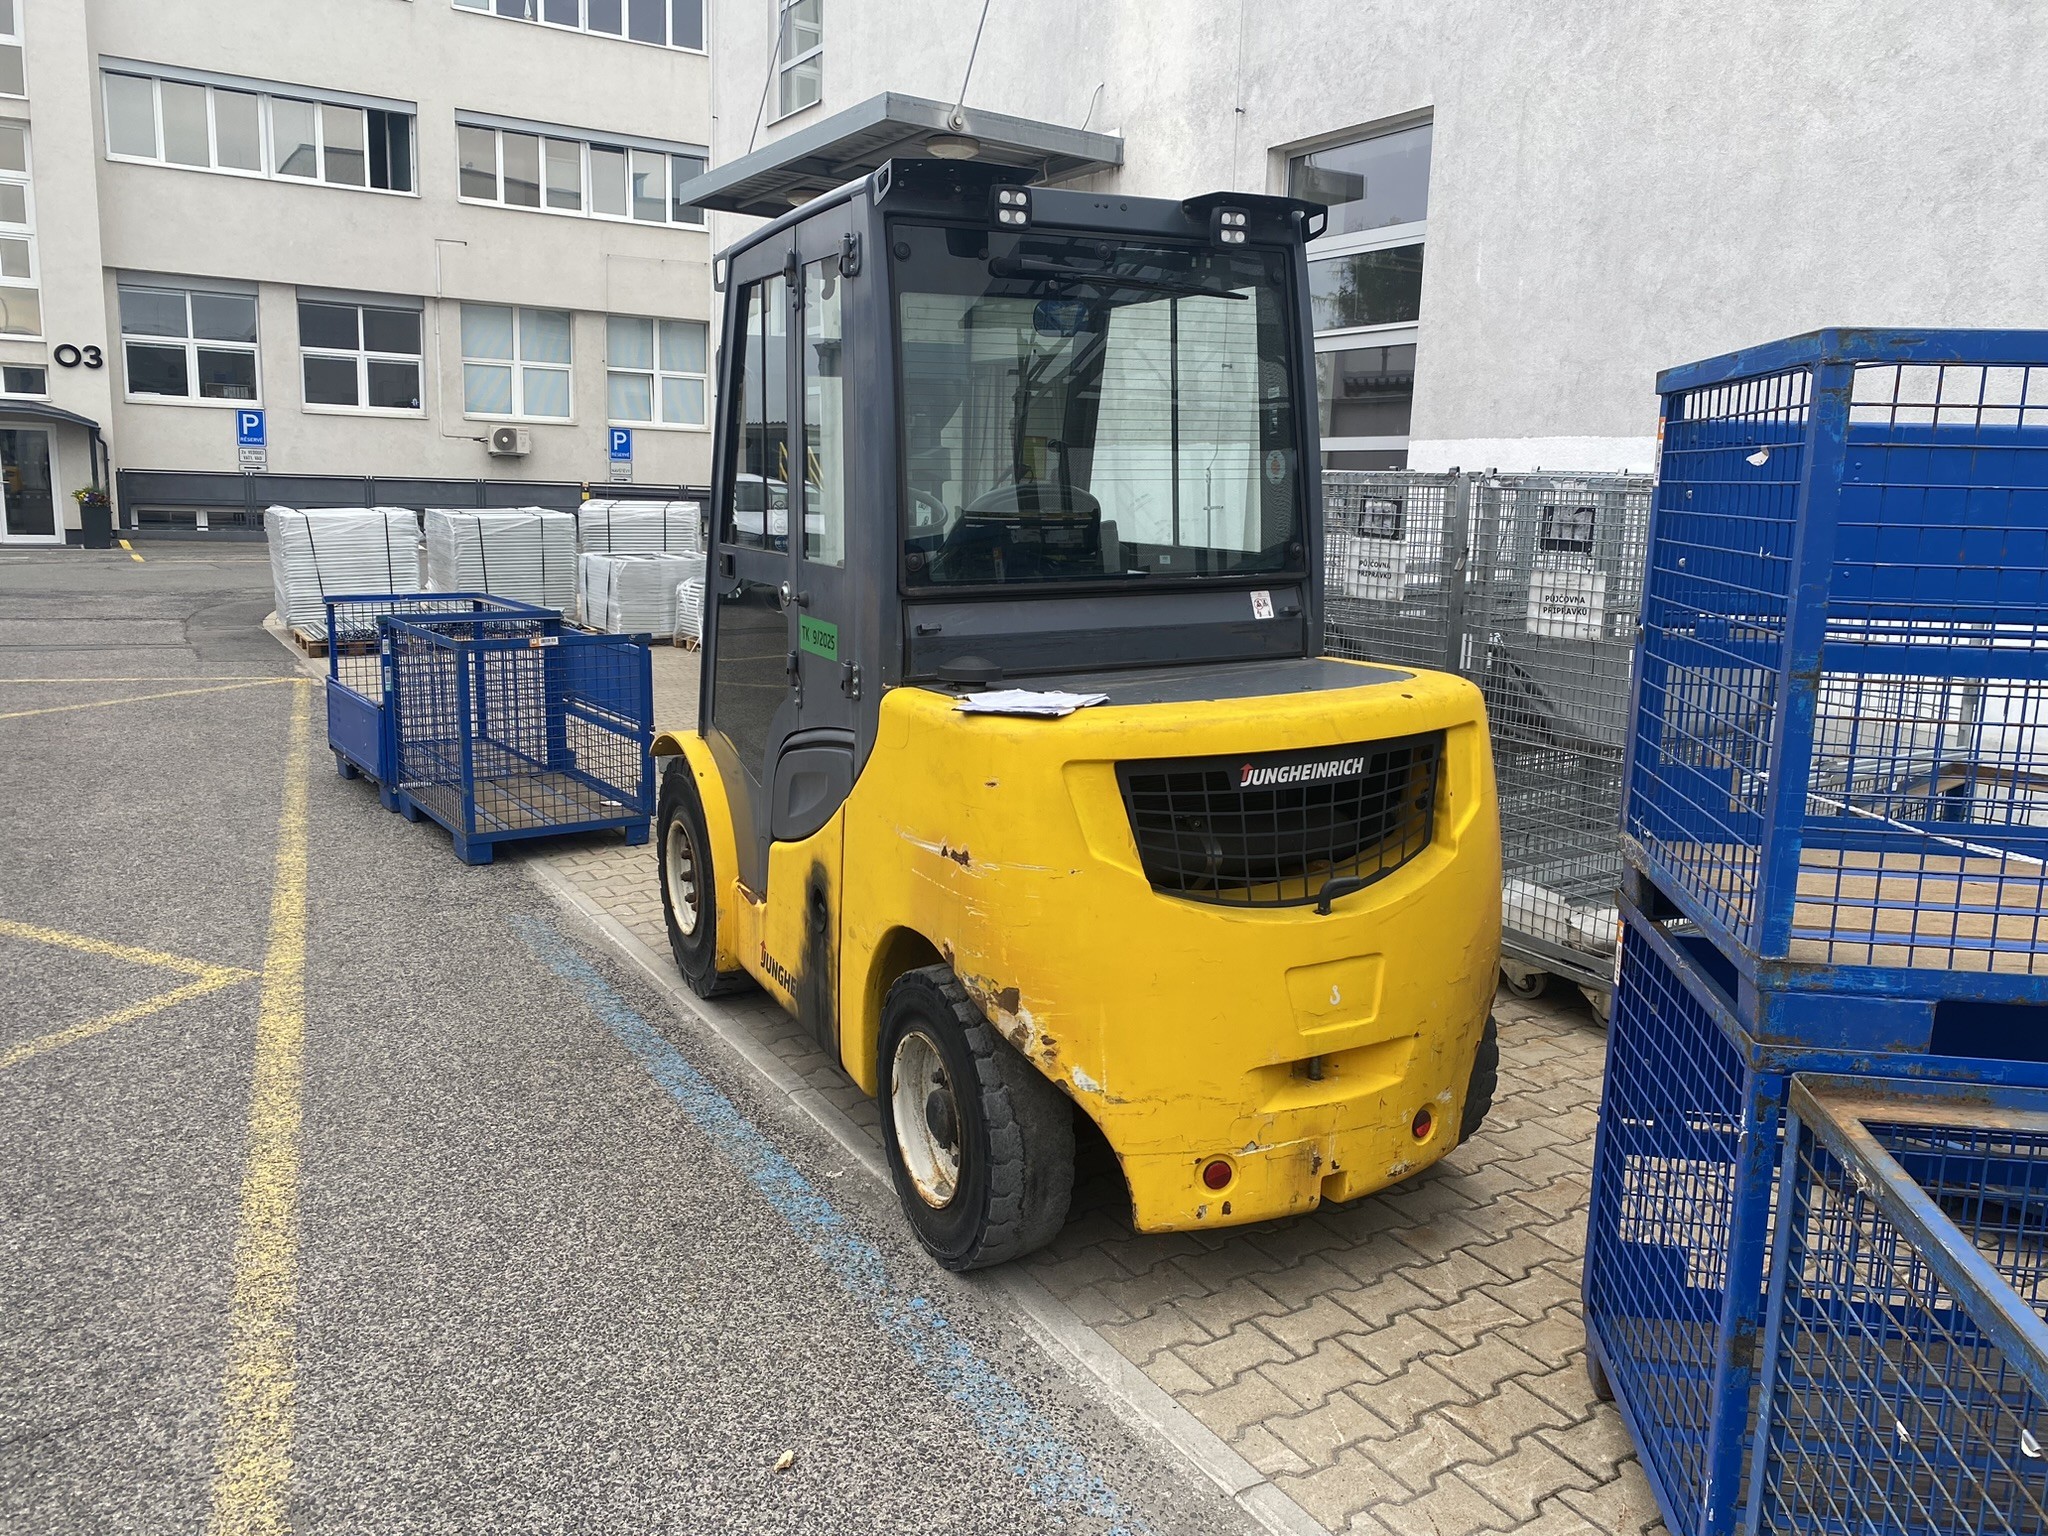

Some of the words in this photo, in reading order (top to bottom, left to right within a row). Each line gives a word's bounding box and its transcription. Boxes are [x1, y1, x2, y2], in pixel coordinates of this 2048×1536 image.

[242, 413, 260, 435] P
[613, 431, 628, 451] P
[802, 625, 810, 642] TK
[813, 629, 835, 651] 9/2025
[1240, 757, 1365, 787] JUNGHEINRICH
